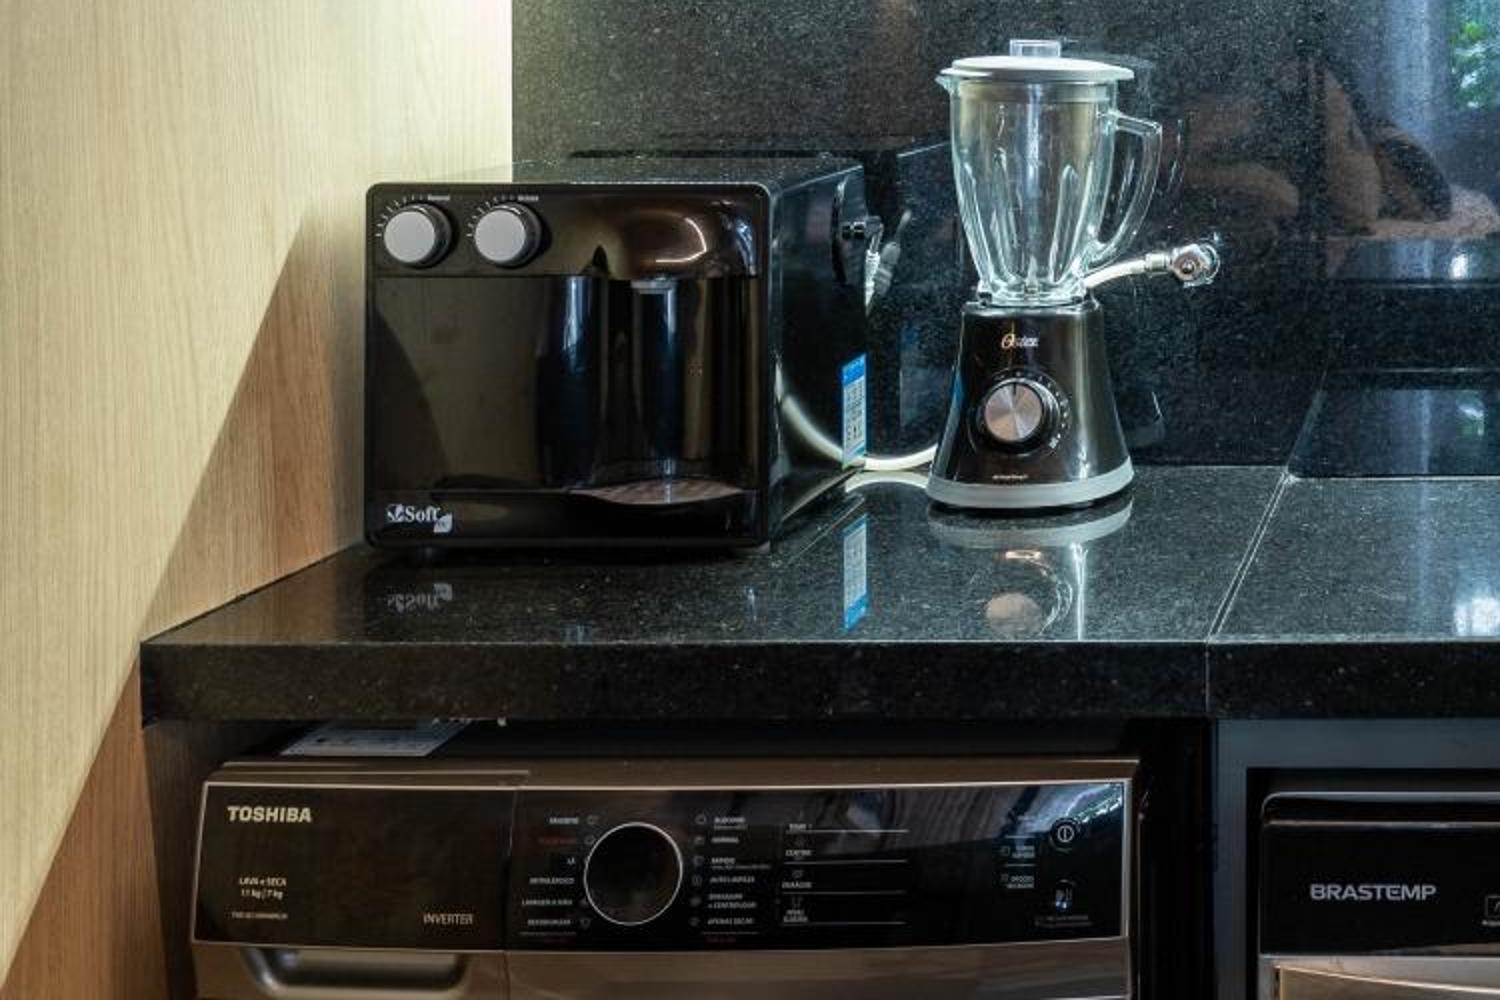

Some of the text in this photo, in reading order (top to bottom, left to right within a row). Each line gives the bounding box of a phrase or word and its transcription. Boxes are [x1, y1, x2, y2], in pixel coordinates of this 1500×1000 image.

[405, 505, 441, 523] Soft
[228, 806, 312, 823] TOSHIBA
[1310, 884, 1437, 901] BRASTEMP
[423, 913, 474, 925] INVERTER
